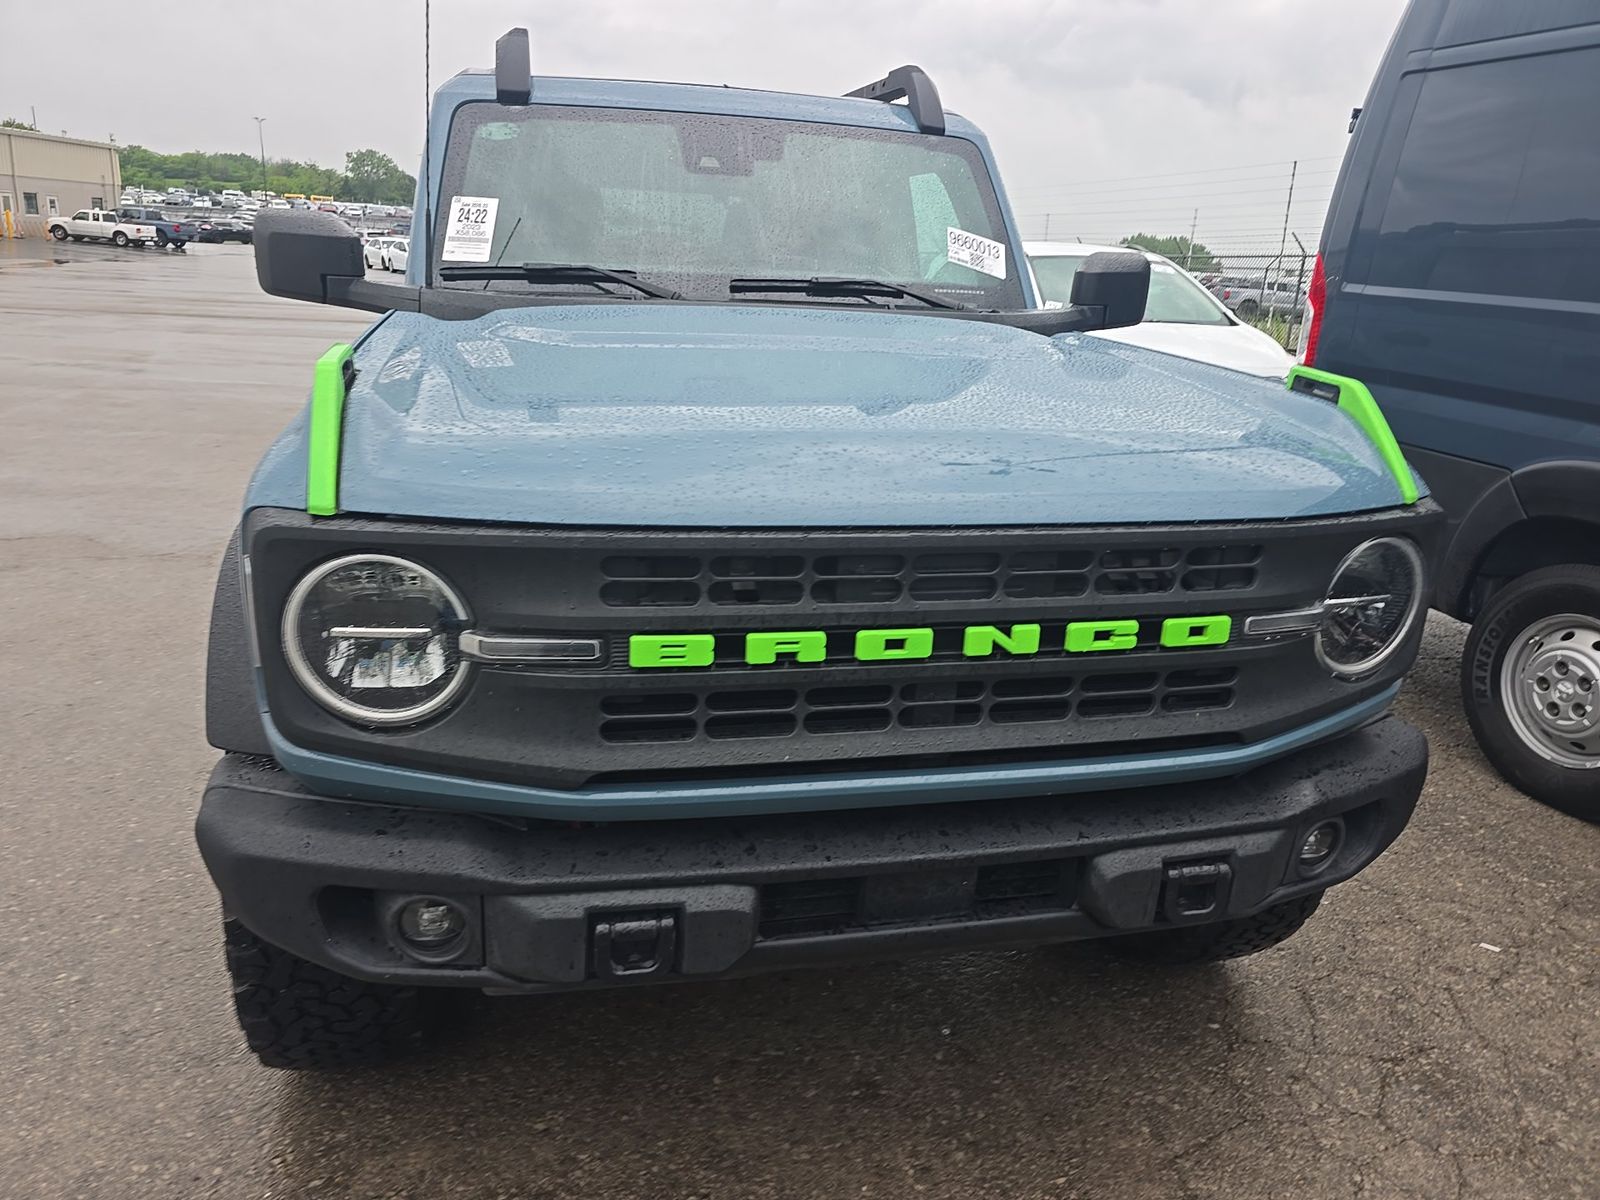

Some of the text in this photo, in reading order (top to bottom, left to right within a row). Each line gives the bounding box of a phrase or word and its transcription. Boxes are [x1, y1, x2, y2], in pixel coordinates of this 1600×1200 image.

[457, 207, 487, 223] 24:22
[949, 231, 1000, 259] 9660013
[628, 614, 1233, 669] BRONCO
